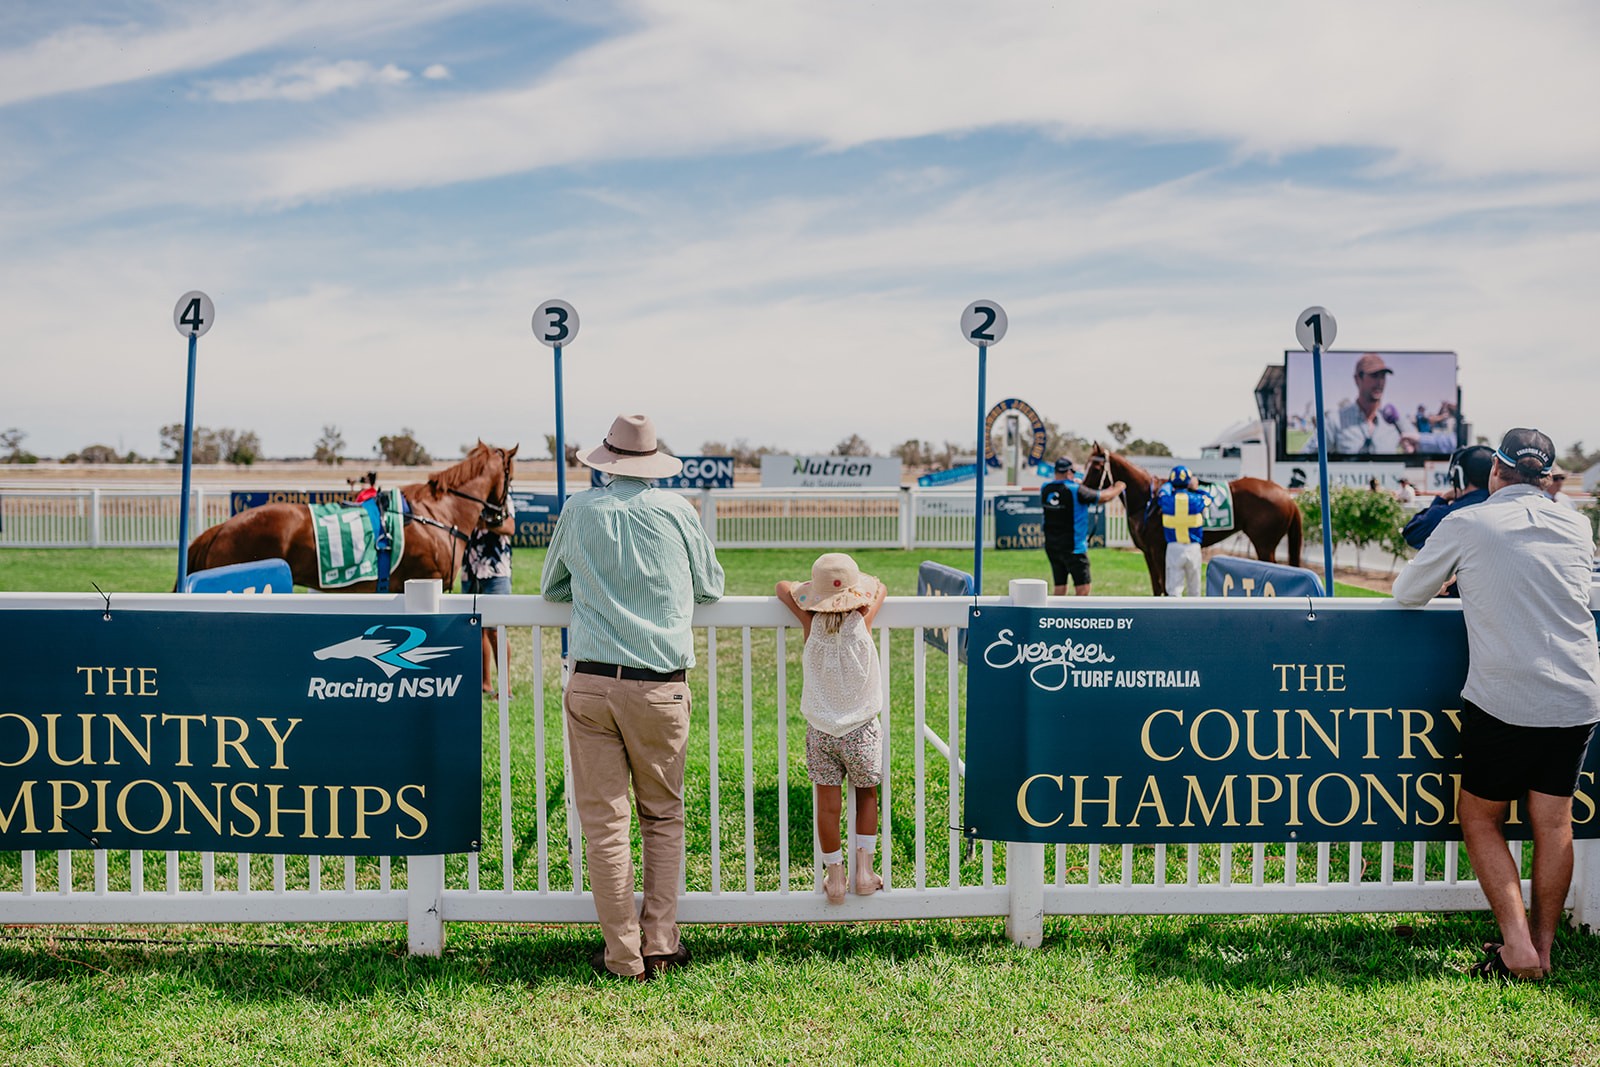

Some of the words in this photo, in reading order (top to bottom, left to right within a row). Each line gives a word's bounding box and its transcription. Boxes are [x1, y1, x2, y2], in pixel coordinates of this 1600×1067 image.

[180, 298, 204, 331] 4
[544, 307, 569, 341] 3
[970, 306, 997, 341] 2
[1304, 314, 1323, 346] 1
[678, 459, 733, 479] GON
[793, 457, 872, 477] Nutrien
[267, 491, 310, 505] JOHN
[1038, 617, 1114, 630] SPONSORED
[1116, 617, 1134, 630] BY
[984, 629, 1115, 691] Evergreen
[77, 666, 159, 696] THE
[307, 677, 393, 703] Racing
[397, 674, 463, 699] NSW
[1071, 670, 1113, 688] TURF
[1114, 670, 1200, 688] AUSTRALIA
[1272, 663, 1347, 692] THE
